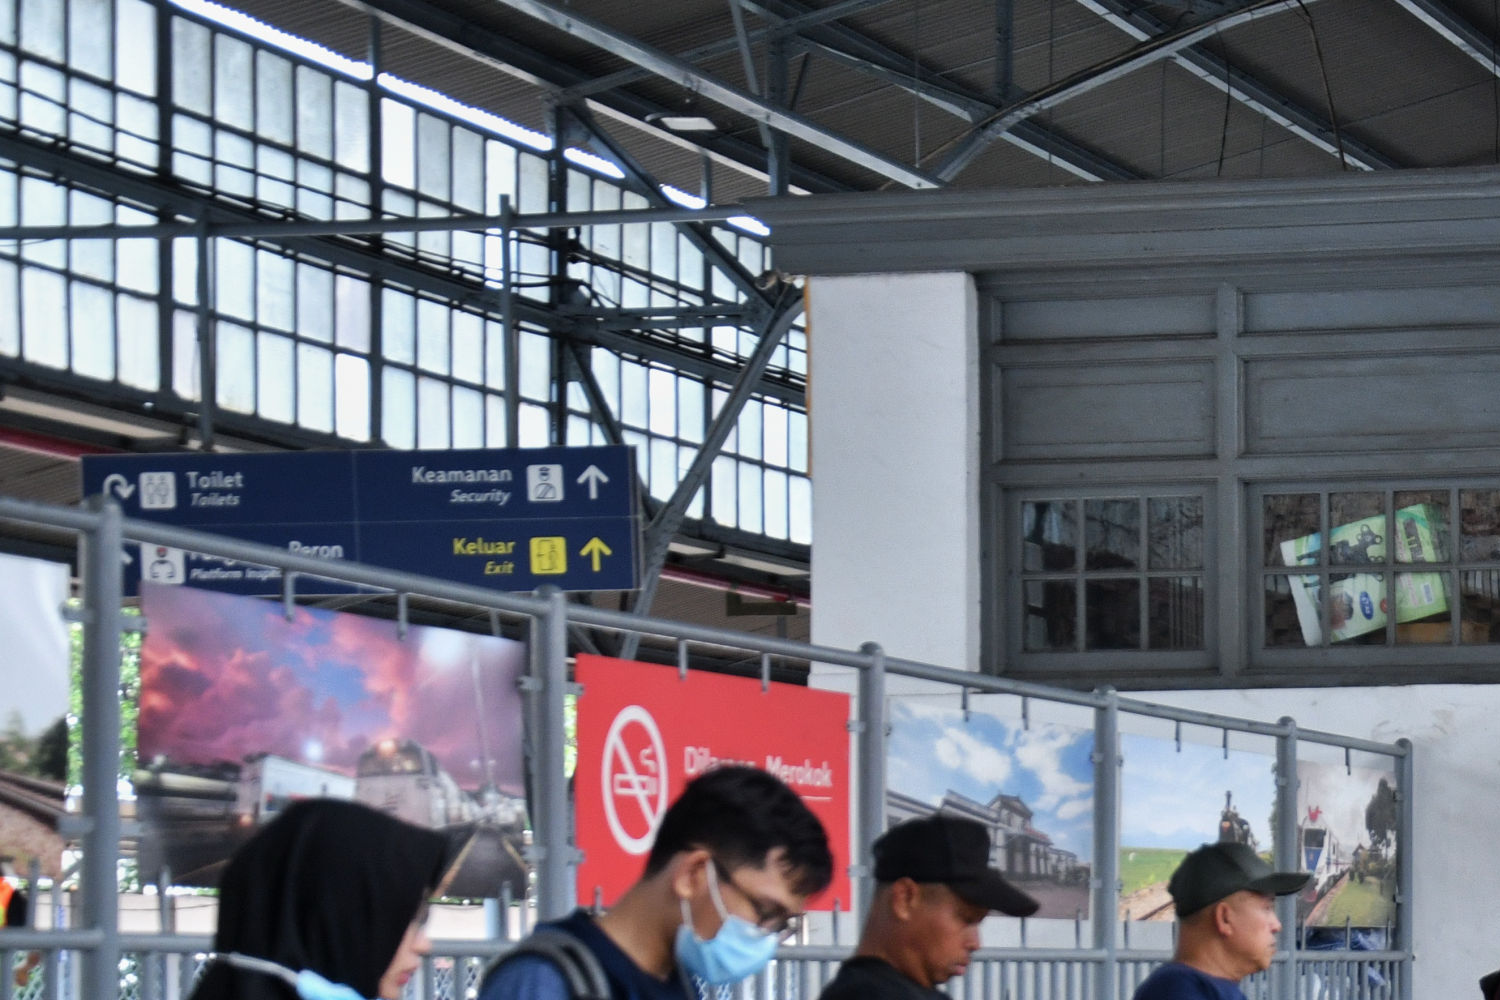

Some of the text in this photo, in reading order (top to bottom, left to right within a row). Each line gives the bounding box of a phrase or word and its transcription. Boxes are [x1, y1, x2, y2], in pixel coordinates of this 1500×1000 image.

[185, 470, 244, 489] Toilet
[411, 465, 512, 483] Keamanan
[190, 492, 241, 506] Toilets
[450, 488, 511, 506] Security
[452, 537, 516, 555] Keluar
[484, 560, 515, 574] Exit
[765, 755, 833, 788] Merokok
